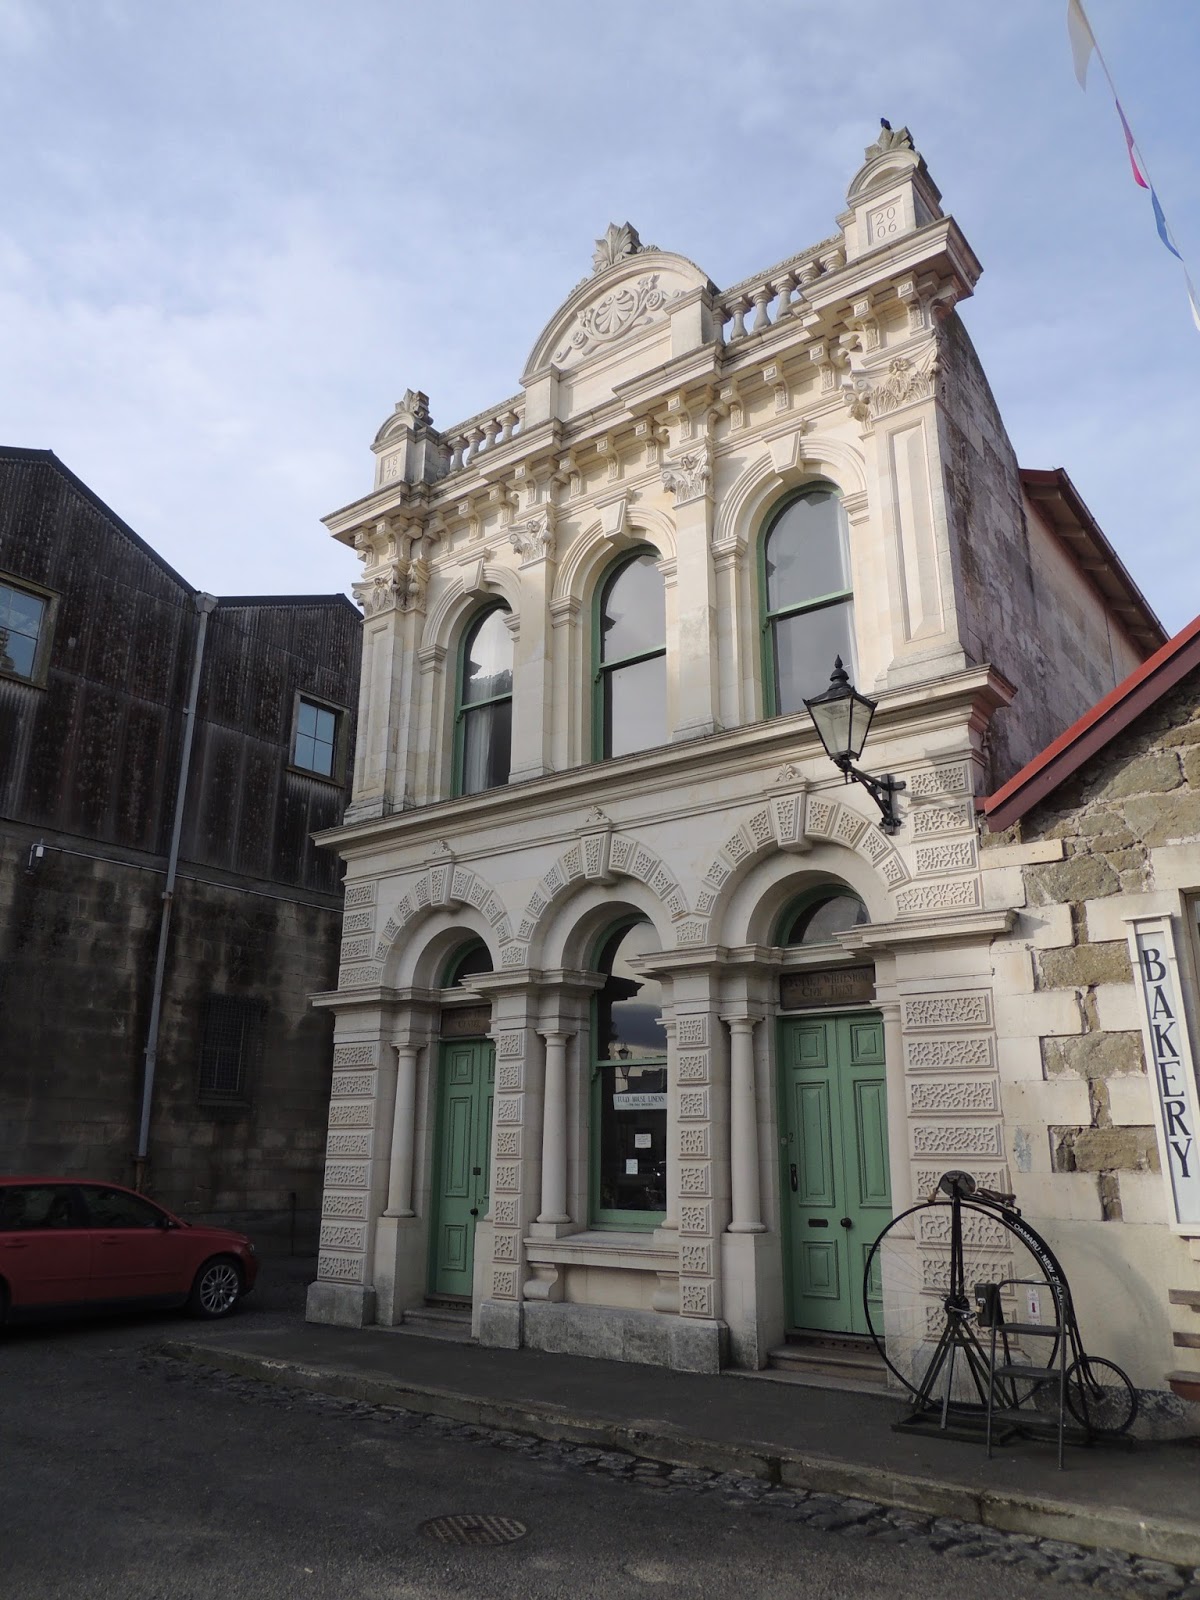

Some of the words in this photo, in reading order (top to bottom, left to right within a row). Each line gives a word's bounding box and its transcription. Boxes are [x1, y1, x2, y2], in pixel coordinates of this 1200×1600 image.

[875, 206, 896, 226] 20
[876, 219, 897, 239] 06
[1142, 947, 1193, 1178] BAKERY
[788, 1132, 794, 1143] 2
[1013, 1222, 1042, 1252] OAMARU
[1040, 1253, 1056, 1273] NEW
